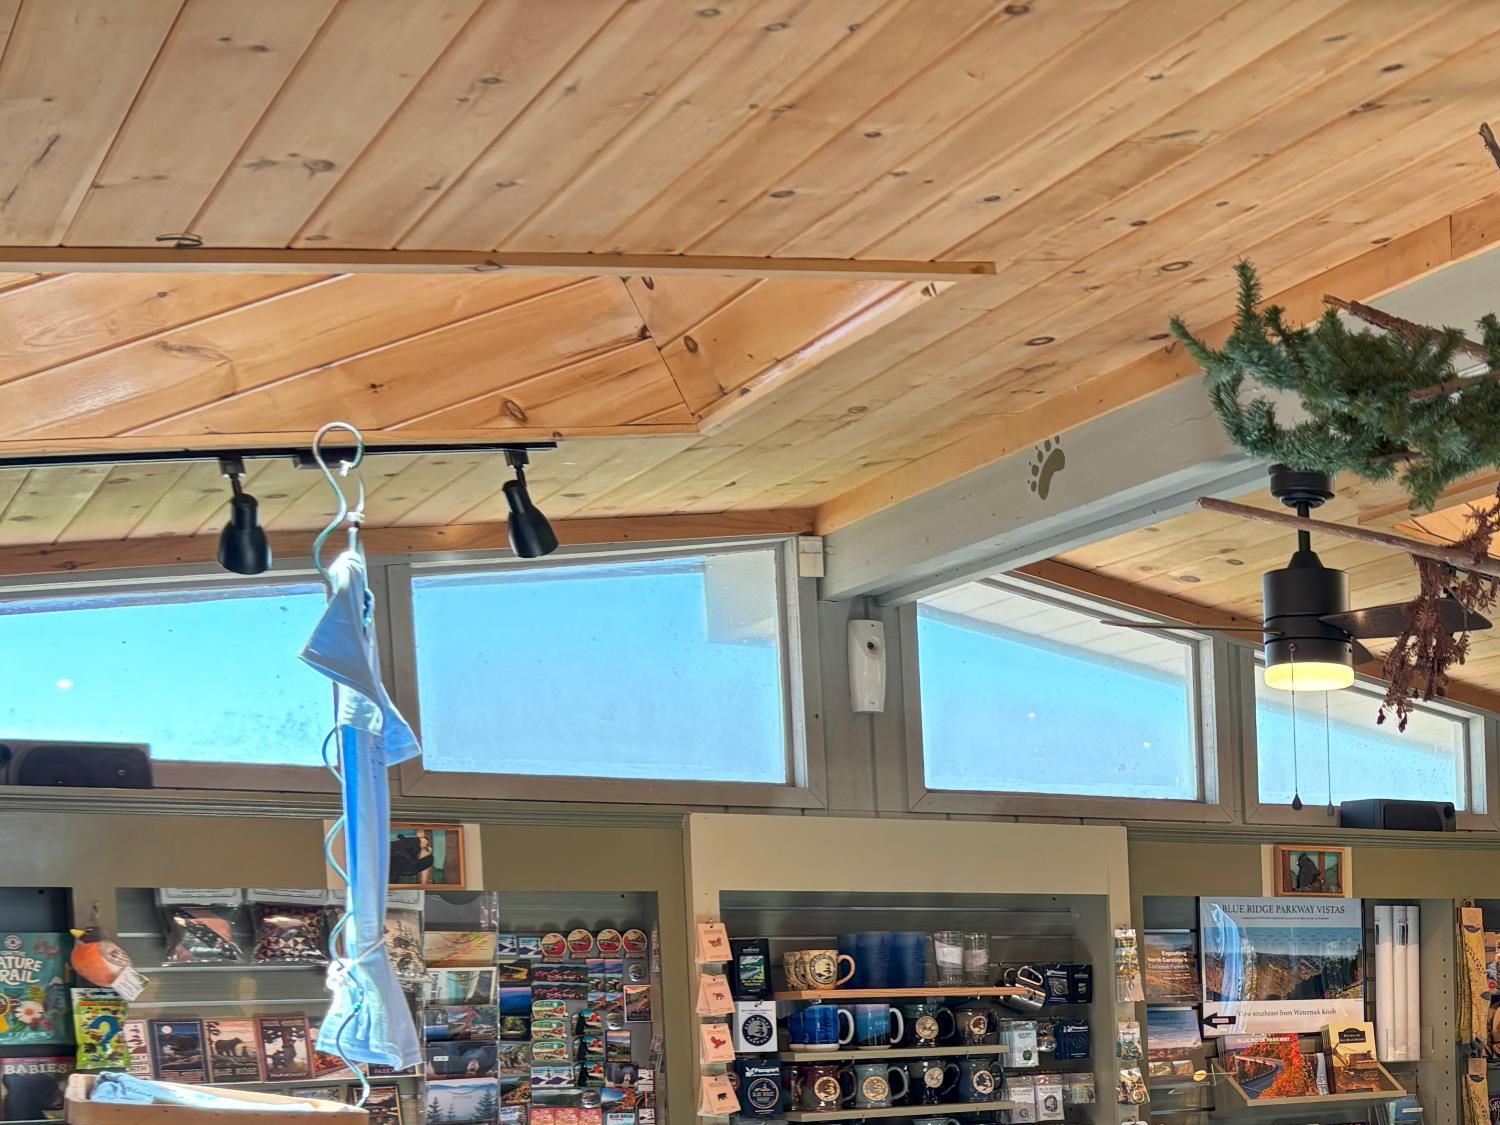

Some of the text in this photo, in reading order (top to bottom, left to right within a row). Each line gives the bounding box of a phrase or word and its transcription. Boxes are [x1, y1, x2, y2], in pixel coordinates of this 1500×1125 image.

[1222, 905, 1345, 914] BLUE RIDGE PARKWAY VISTAS
[5, 1064, 67, 1075] BABIES
